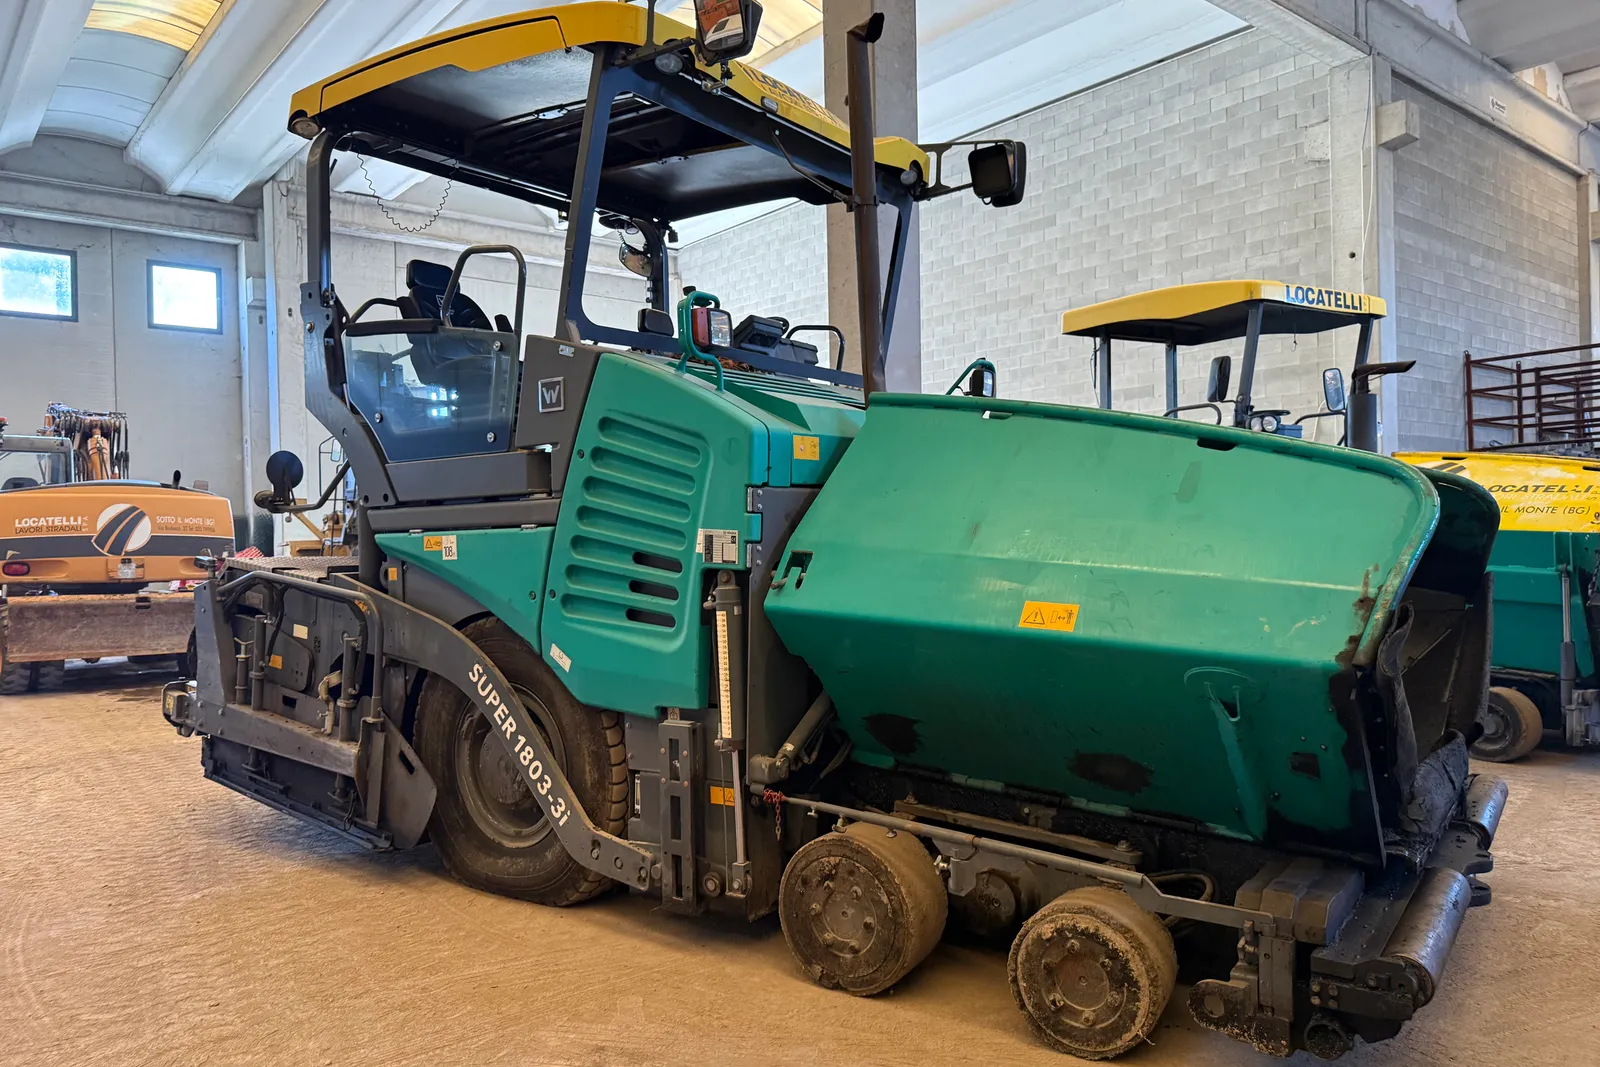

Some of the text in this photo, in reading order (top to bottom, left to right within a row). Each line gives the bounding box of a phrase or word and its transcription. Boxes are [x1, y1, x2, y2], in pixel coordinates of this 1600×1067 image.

[1285, 284, 1363, 312] LOCATELLI
[1482, 484, 1594, 493] OCATELLI
[1514, 505, 1558, 514] MONTE
[1563, 505, 1591, 515] (BG)
[15, 516, 82, 527] LOCATELLI
[156, 515, 176, 524] SOTTO
[177, 516, 183, 524] IL
[184, 516, 204, 525] MONTE
[15, 526, 43, 534] LAVORI
[468, 663, 571, 827] SUPER 1803-3i
